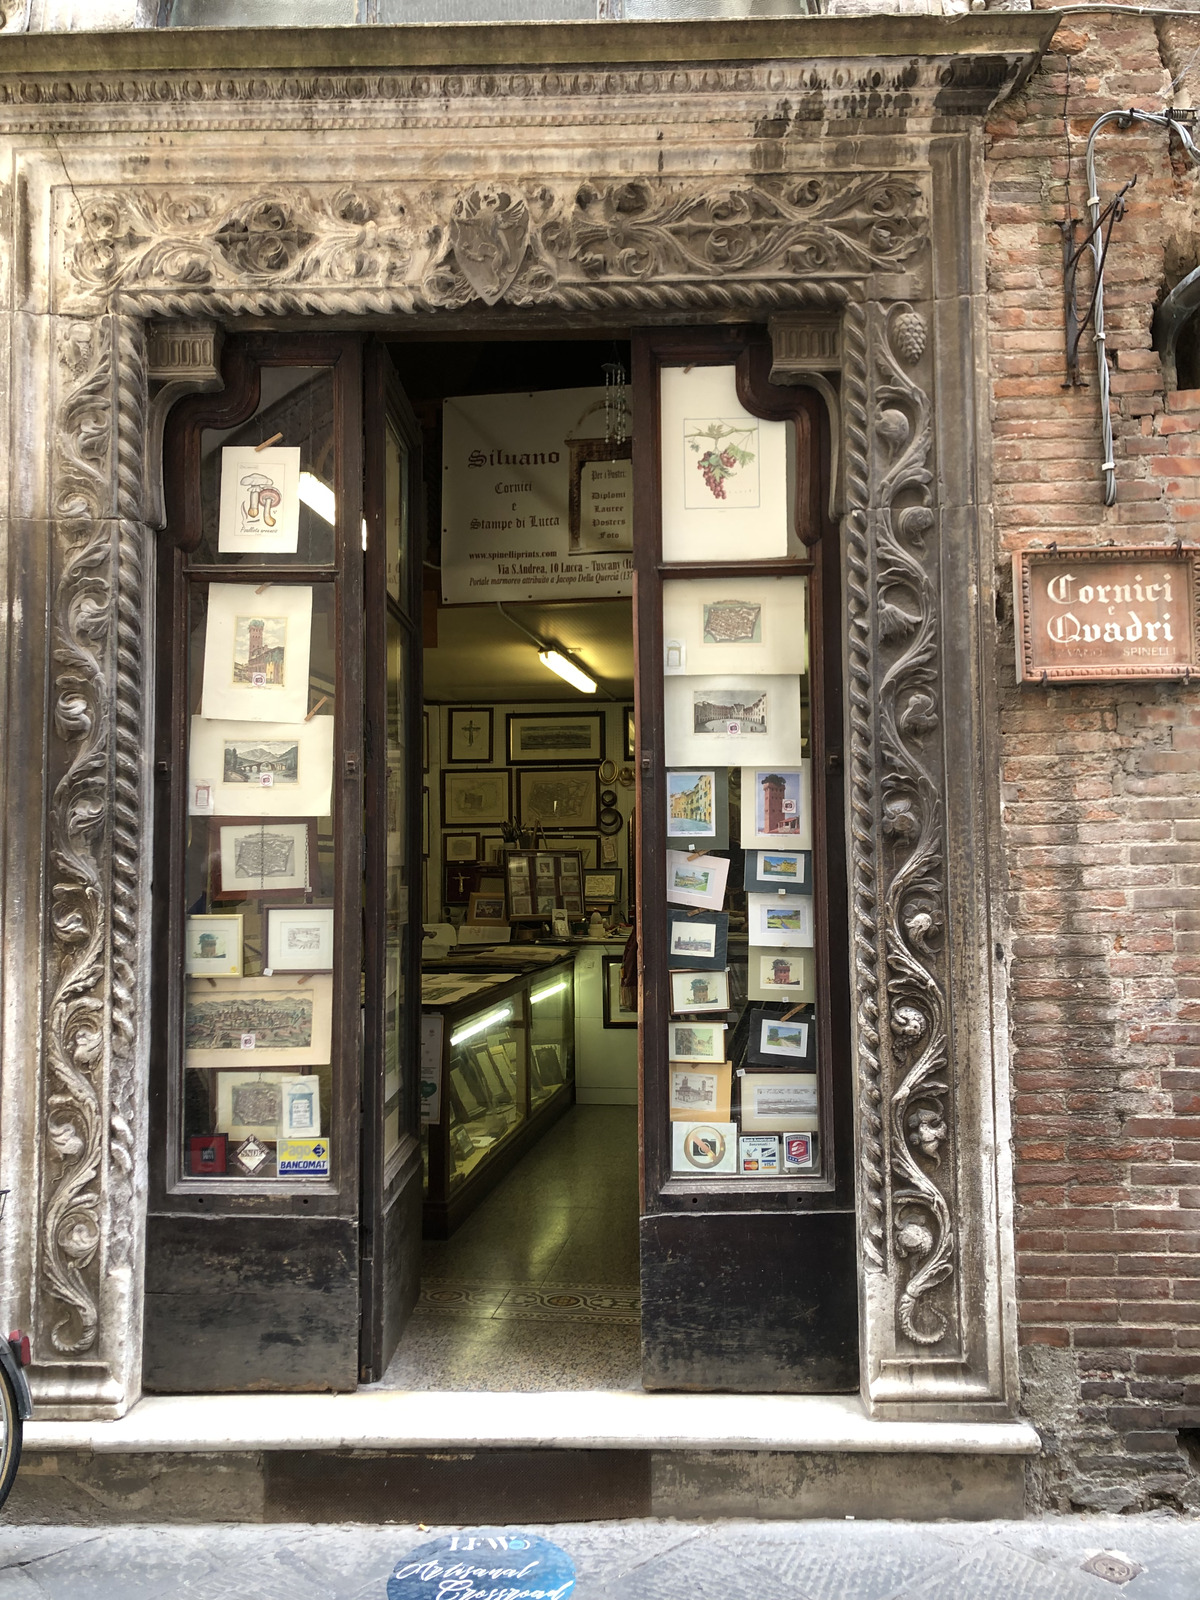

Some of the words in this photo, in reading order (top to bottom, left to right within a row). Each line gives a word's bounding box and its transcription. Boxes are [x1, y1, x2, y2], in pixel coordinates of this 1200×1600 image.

[494, 482, 532, 494] Cornici
[592, 492, 626, 500] Diplomi
[511, 502, 517, 511] e
[470, 518, 513, 531] Stampe
[516, 517, 526, 528] di
[529, 515, 560, 527] Lucca
[592, 519, 626, 527] Posters
[469, 550, 557, 560] www.spinelliprints.com
[498, 563, 510, 575] Via
[550, 562, 559, 573] 10
[561, 562, 583, 573] Lucca
[1047, 573, 1174, 605] Cornici
[1107, 605, 1116, 616] e
[1122, 646, 1177, 657] SPINELLI
[279, 1140, 312, 1160] Pago
[280, 1160, 327, 1169] BANCOMAT
